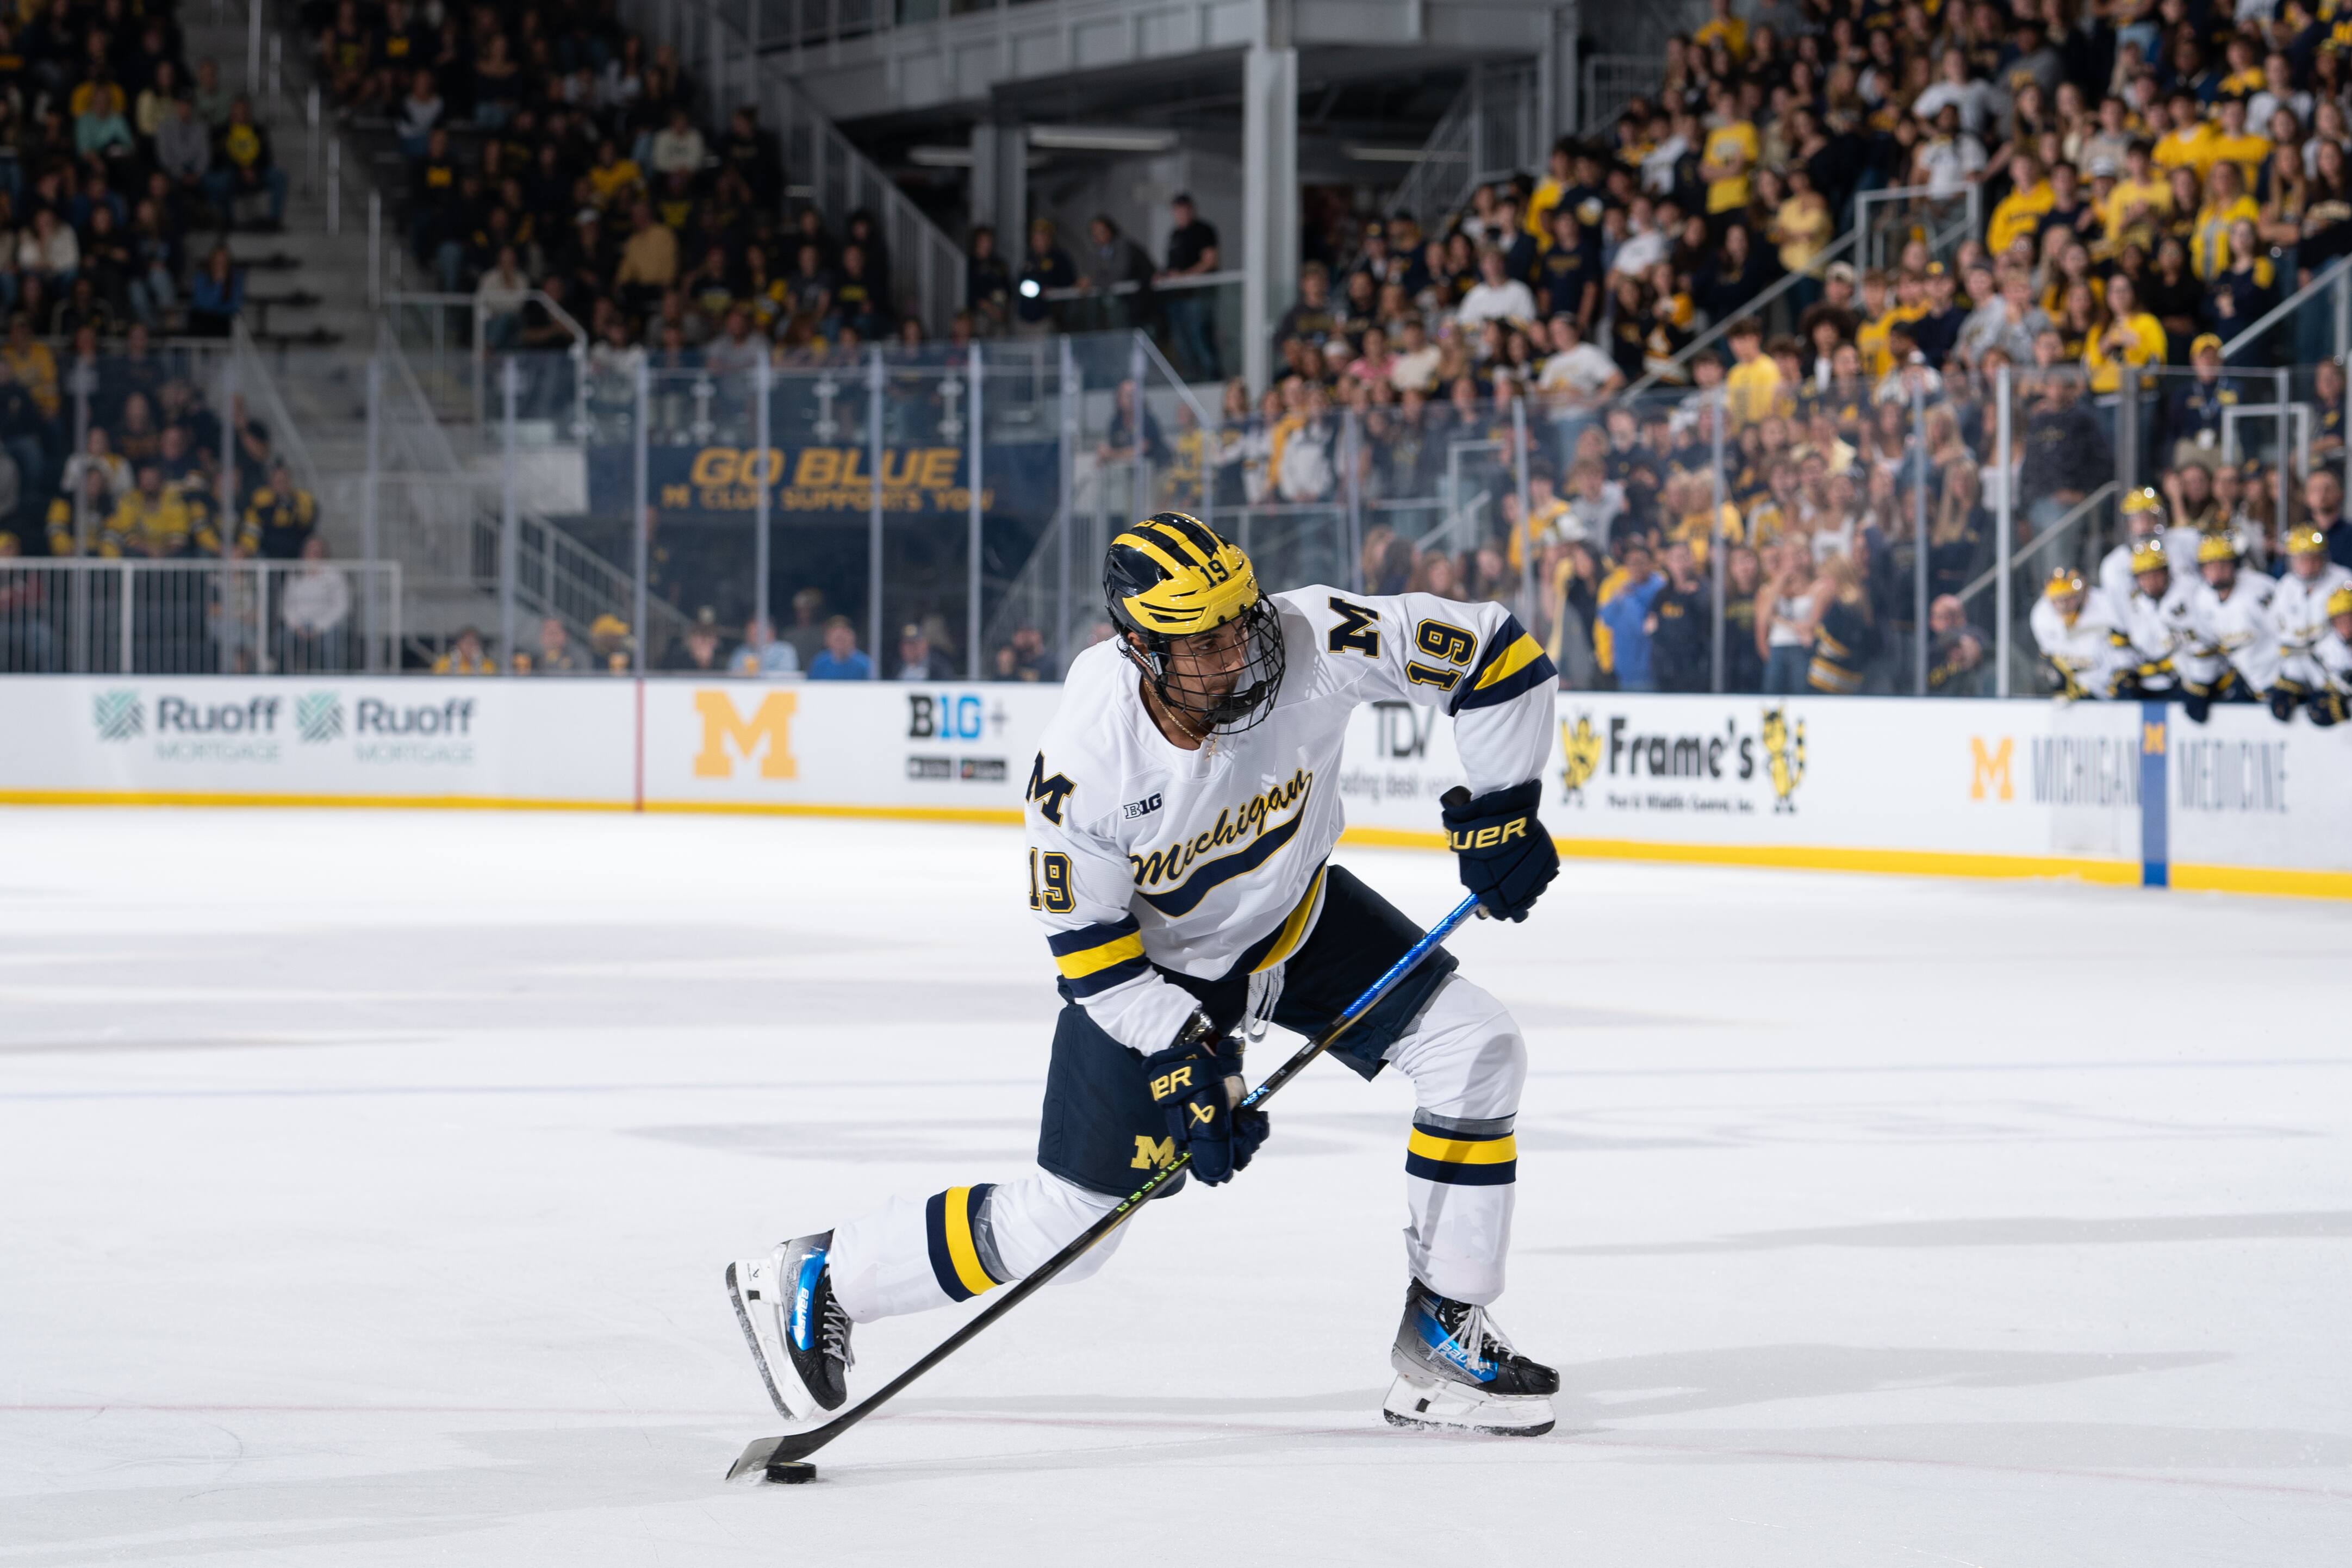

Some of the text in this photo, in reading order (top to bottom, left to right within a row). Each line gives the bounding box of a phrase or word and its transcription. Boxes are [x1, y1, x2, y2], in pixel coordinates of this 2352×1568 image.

[690, 447, 961, 488] GO BLUE
[700, 487, 773, 511] CLU
[1199, 559, 1229, 588] 19
[1328, 595, 1381, 659] M
[1405, 618, 1478, 692] 19
[157, 695, 476, 736] Ruoff Ruoff
[693, 690, 798, 780] M
[154, 739, 475, 763] MORTGAGE MORTGAGE
[1608, 716, 1755, 780] Frame's
[1970, 737, 2014, 801] M
[1025, 749, 1077, 827] M
[1130, 768, 1312, 888] Michigan
[1029, 847, 1076, 914] 19
[1130, 1135, 1176, 1169] M
